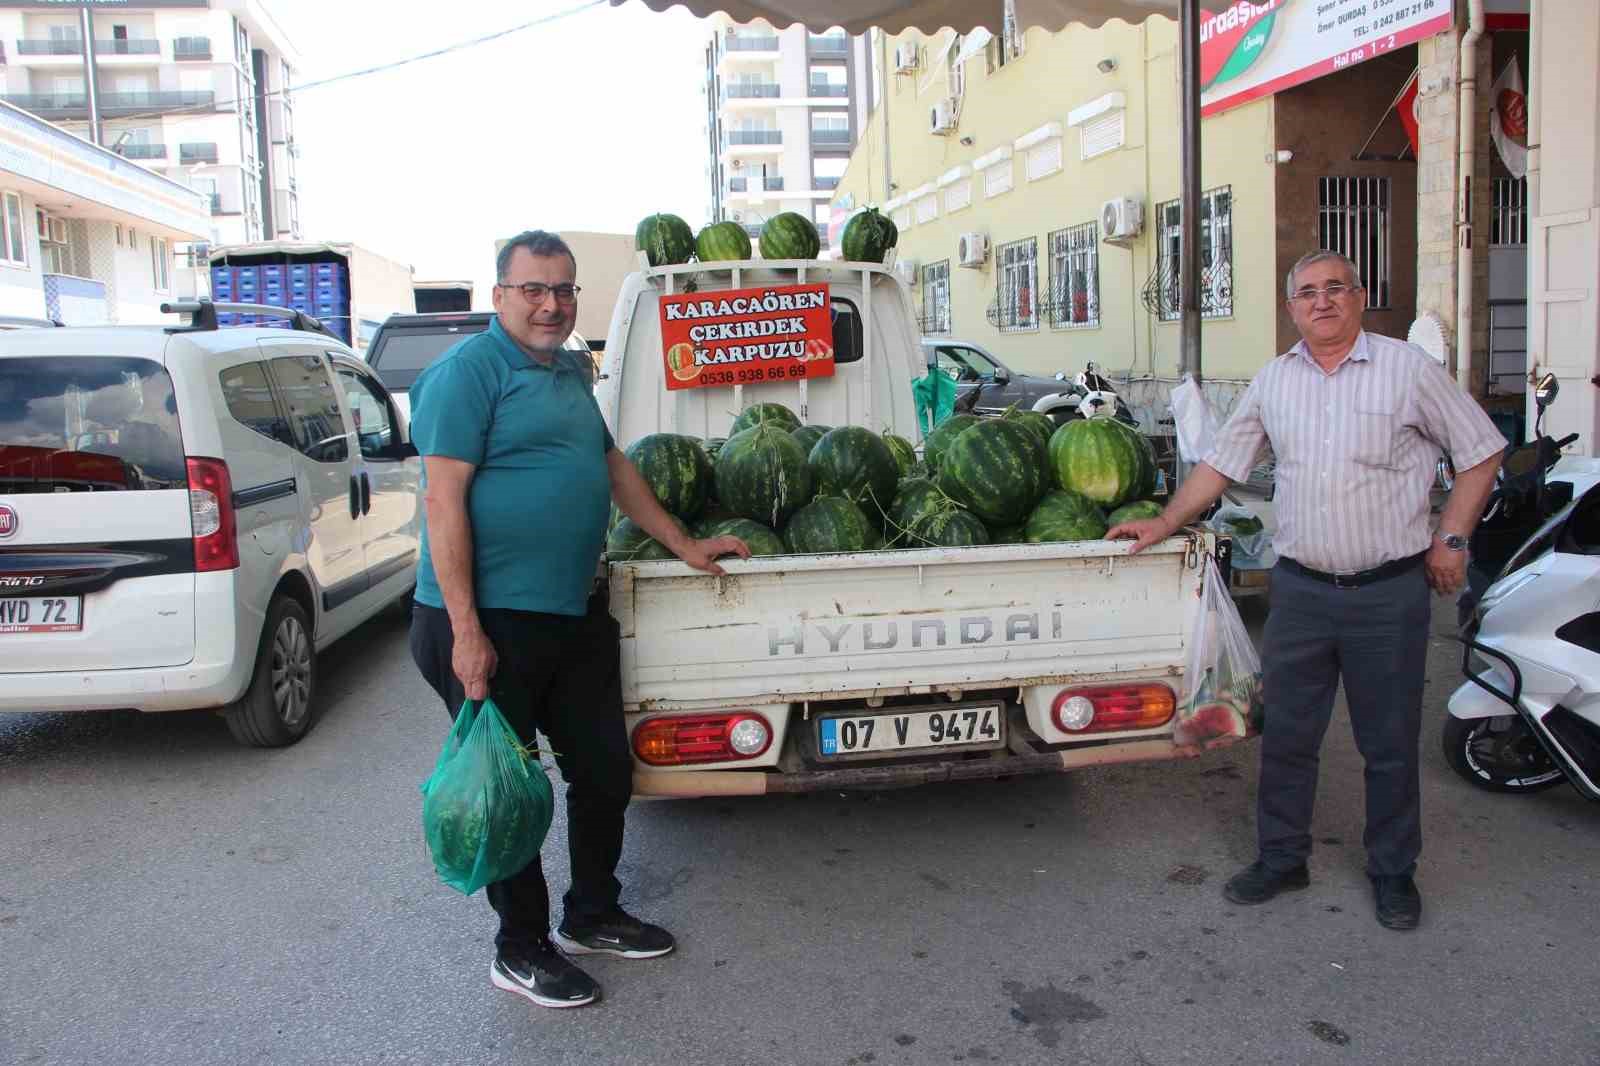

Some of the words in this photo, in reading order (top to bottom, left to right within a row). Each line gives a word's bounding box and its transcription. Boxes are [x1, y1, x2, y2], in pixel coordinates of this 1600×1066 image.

[1373, 20, 1378, 30] 0
[1380, 14, 1394, 27] 242
[1351, 48, 1364, 63] no
[1371, 42, 1376, 55] 1
[1388, 35, 1395, 48] 2
[665, 291, 825, 321] KARACAÖREN
[693, 340, 805, 366] KARPUZU
[701, 369, 734, 385] 0538
[738, 368, 764, 382] 938
[768, 366, 785, 379] 66
[789, 365, 806, 377] 69
[42, 599, 66, 622] 72
[768, 611, 1062, 656] HYUNDAI
[841, 719, 875, 750] 07
[895, 716, 910, 746] V
[928, 710, 995, 743] 9474
[823, 738, 836, 749] TR
